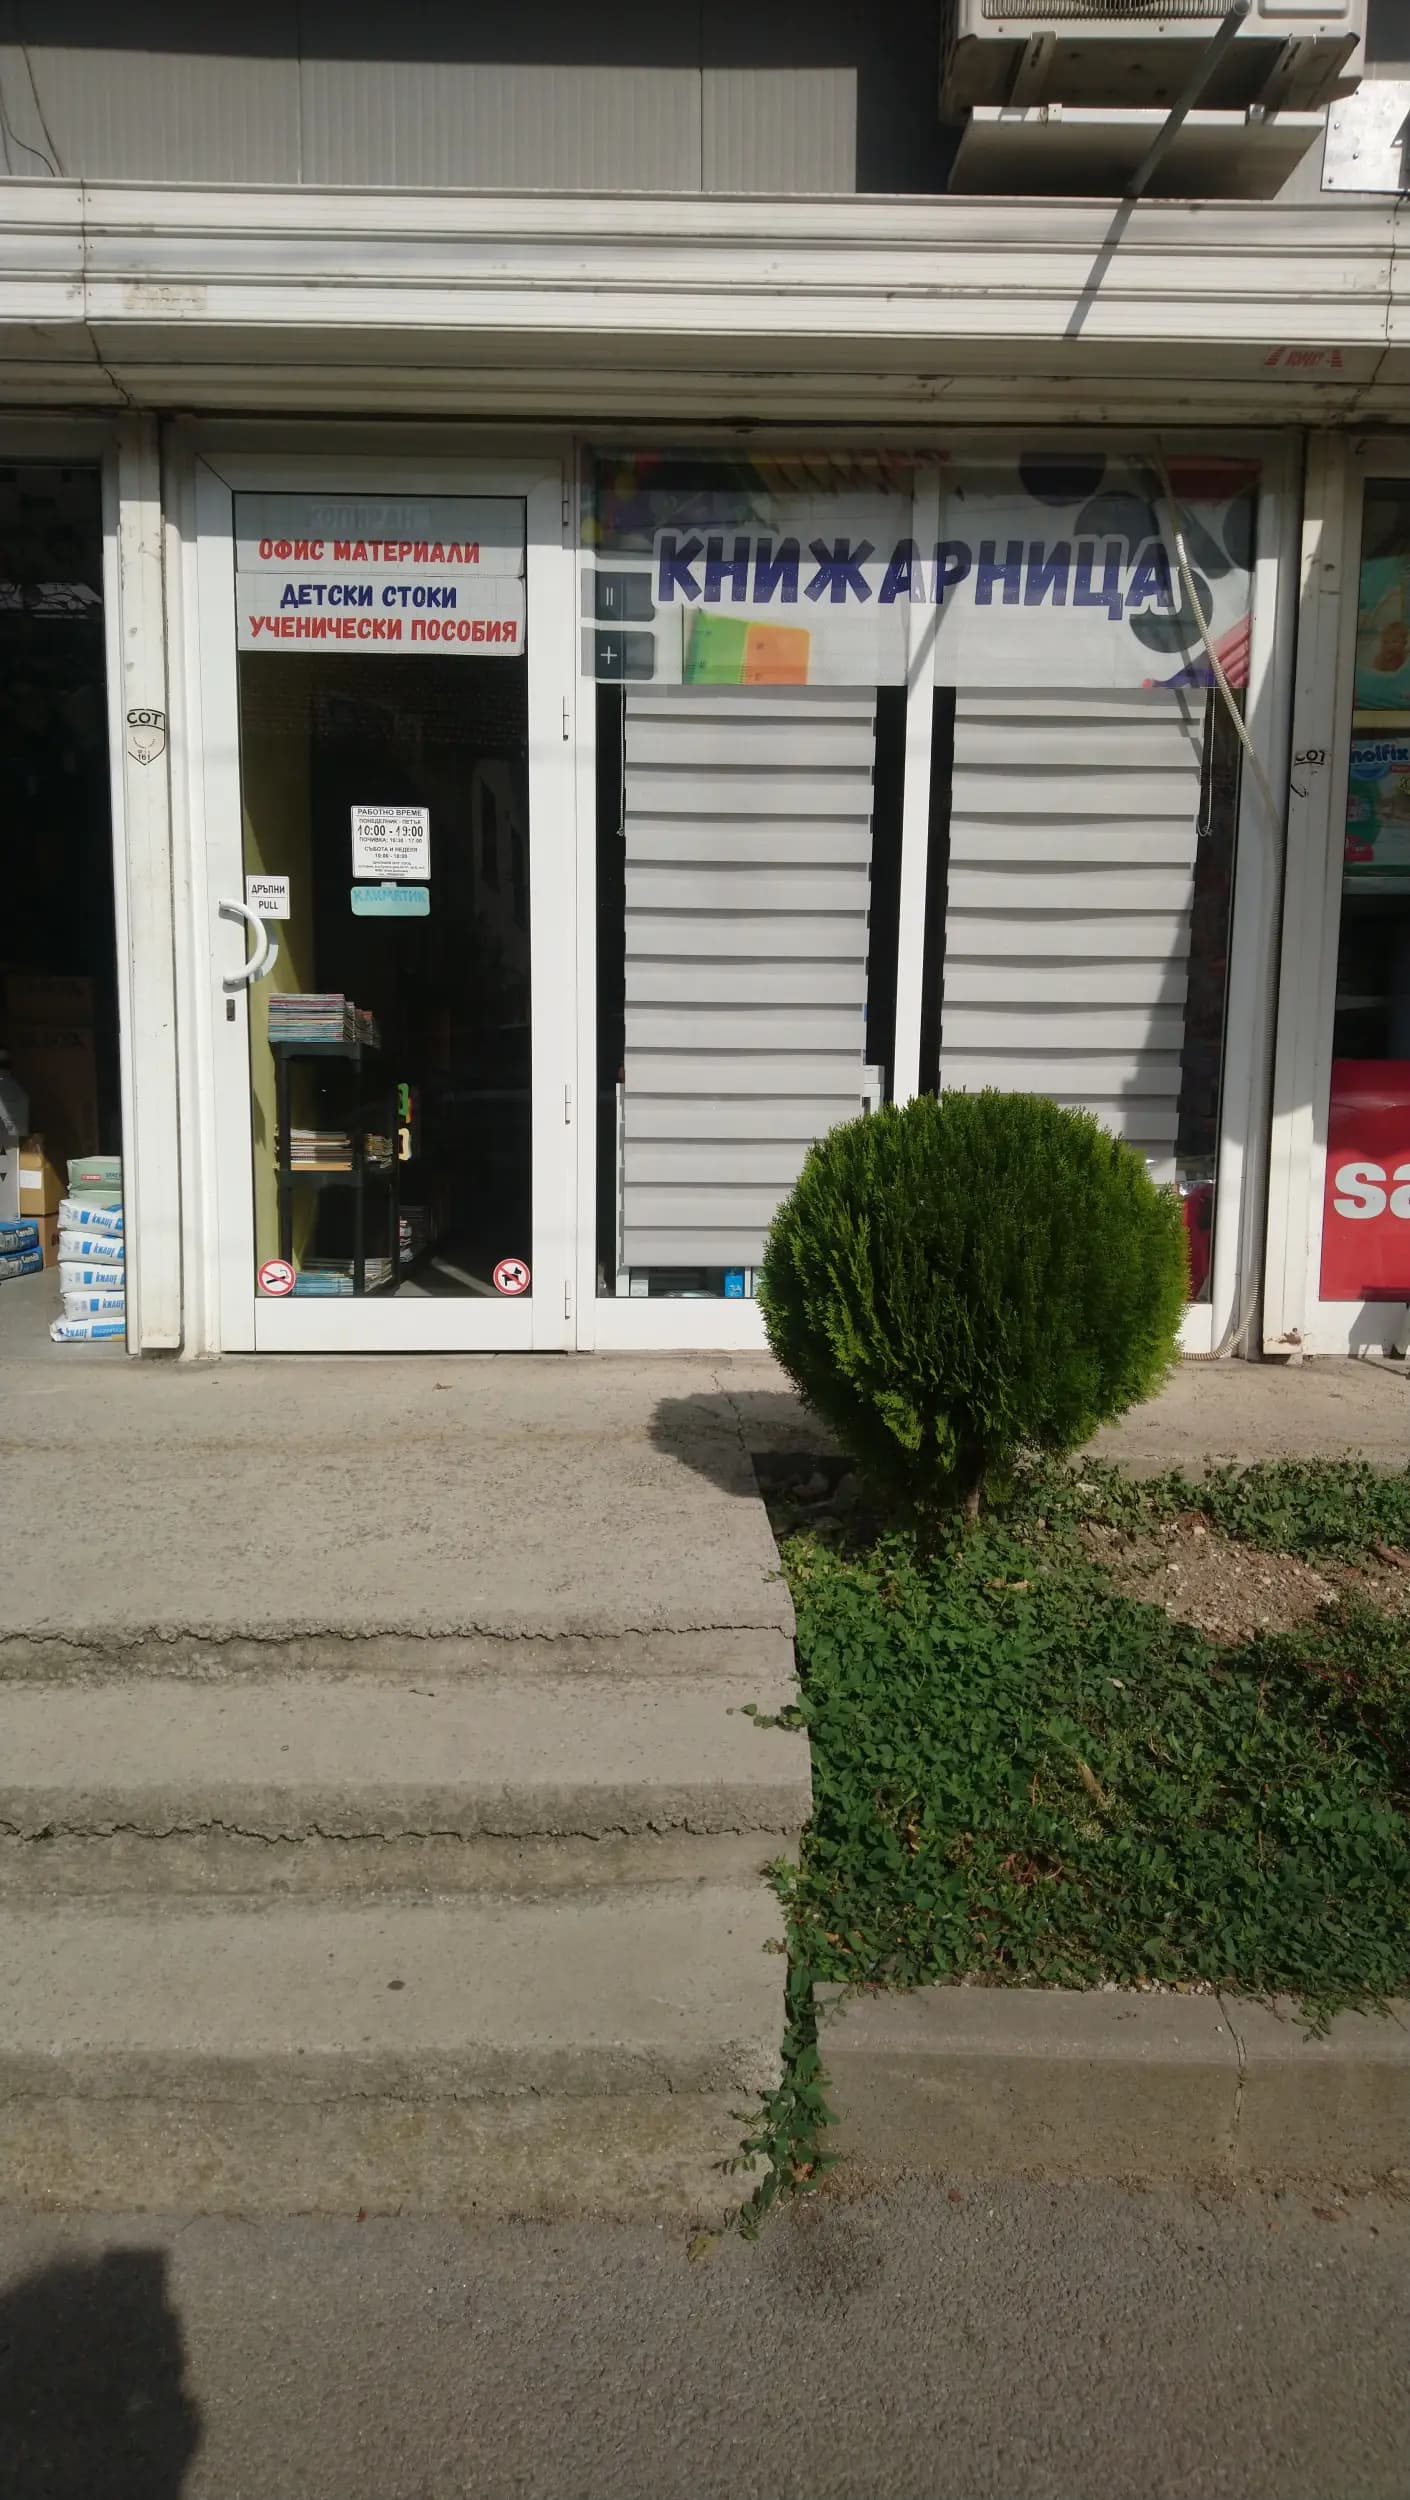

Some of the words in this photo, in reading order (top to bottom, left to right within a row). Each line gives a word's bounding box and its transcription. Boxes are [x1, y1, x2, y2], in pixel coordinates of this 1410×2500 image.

[258, 537, 324, 561] ОФИС
[333, 540, 480, 564] МАТЕРИАЛИ
[657, 535, 1174, 621] КНИЖАРНИЦА
[279, 583, 373, 609] ДЕТСКИ
[382, 585, 457, 609] СТОКИ
[248, 615, 402, 640] УЧЕНИЧЕСКИ
[410, 619, 518, 643] ПОСОБИЯ
[357, 808, 394, 816] РАБОТНО
[396, 809, 422, 817] ВРЕМЕ
[357, 824, 386, 836] 10:00
[396, 825, 423, 837] 19:00
[251, 884, 286, 894] ДРЪПНИ
[258, 900, 279, 910] PULL
